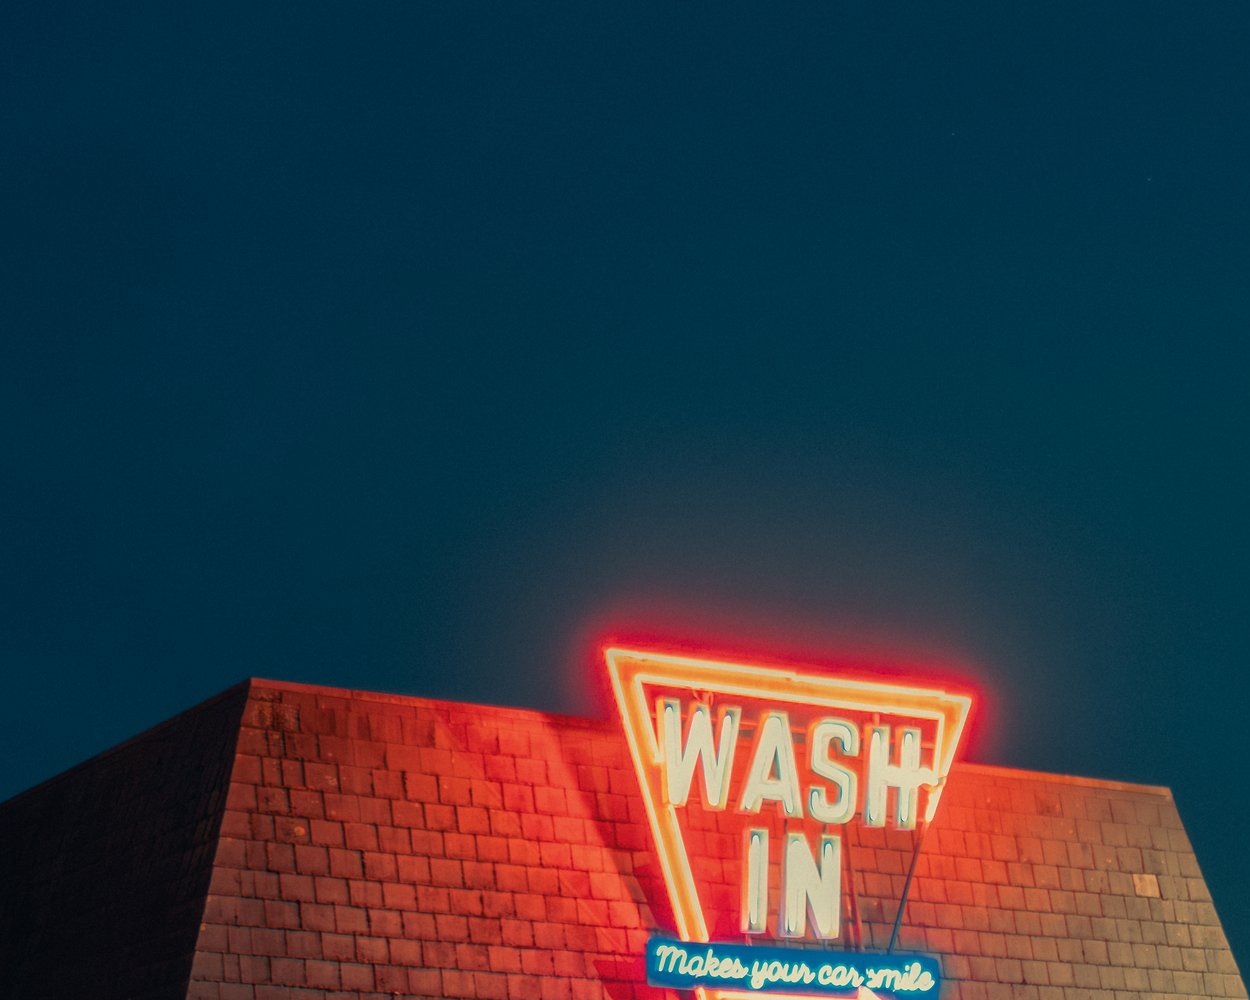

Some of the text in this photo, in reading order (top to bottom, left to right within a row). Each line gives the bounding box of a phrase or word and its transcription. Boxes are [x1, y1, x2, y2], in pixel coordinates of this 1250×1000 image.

[657, 697, 940, 830] WASH
[742, 828, 842, 939] IN
[656, 945, 935, 991] Makes your car smile
